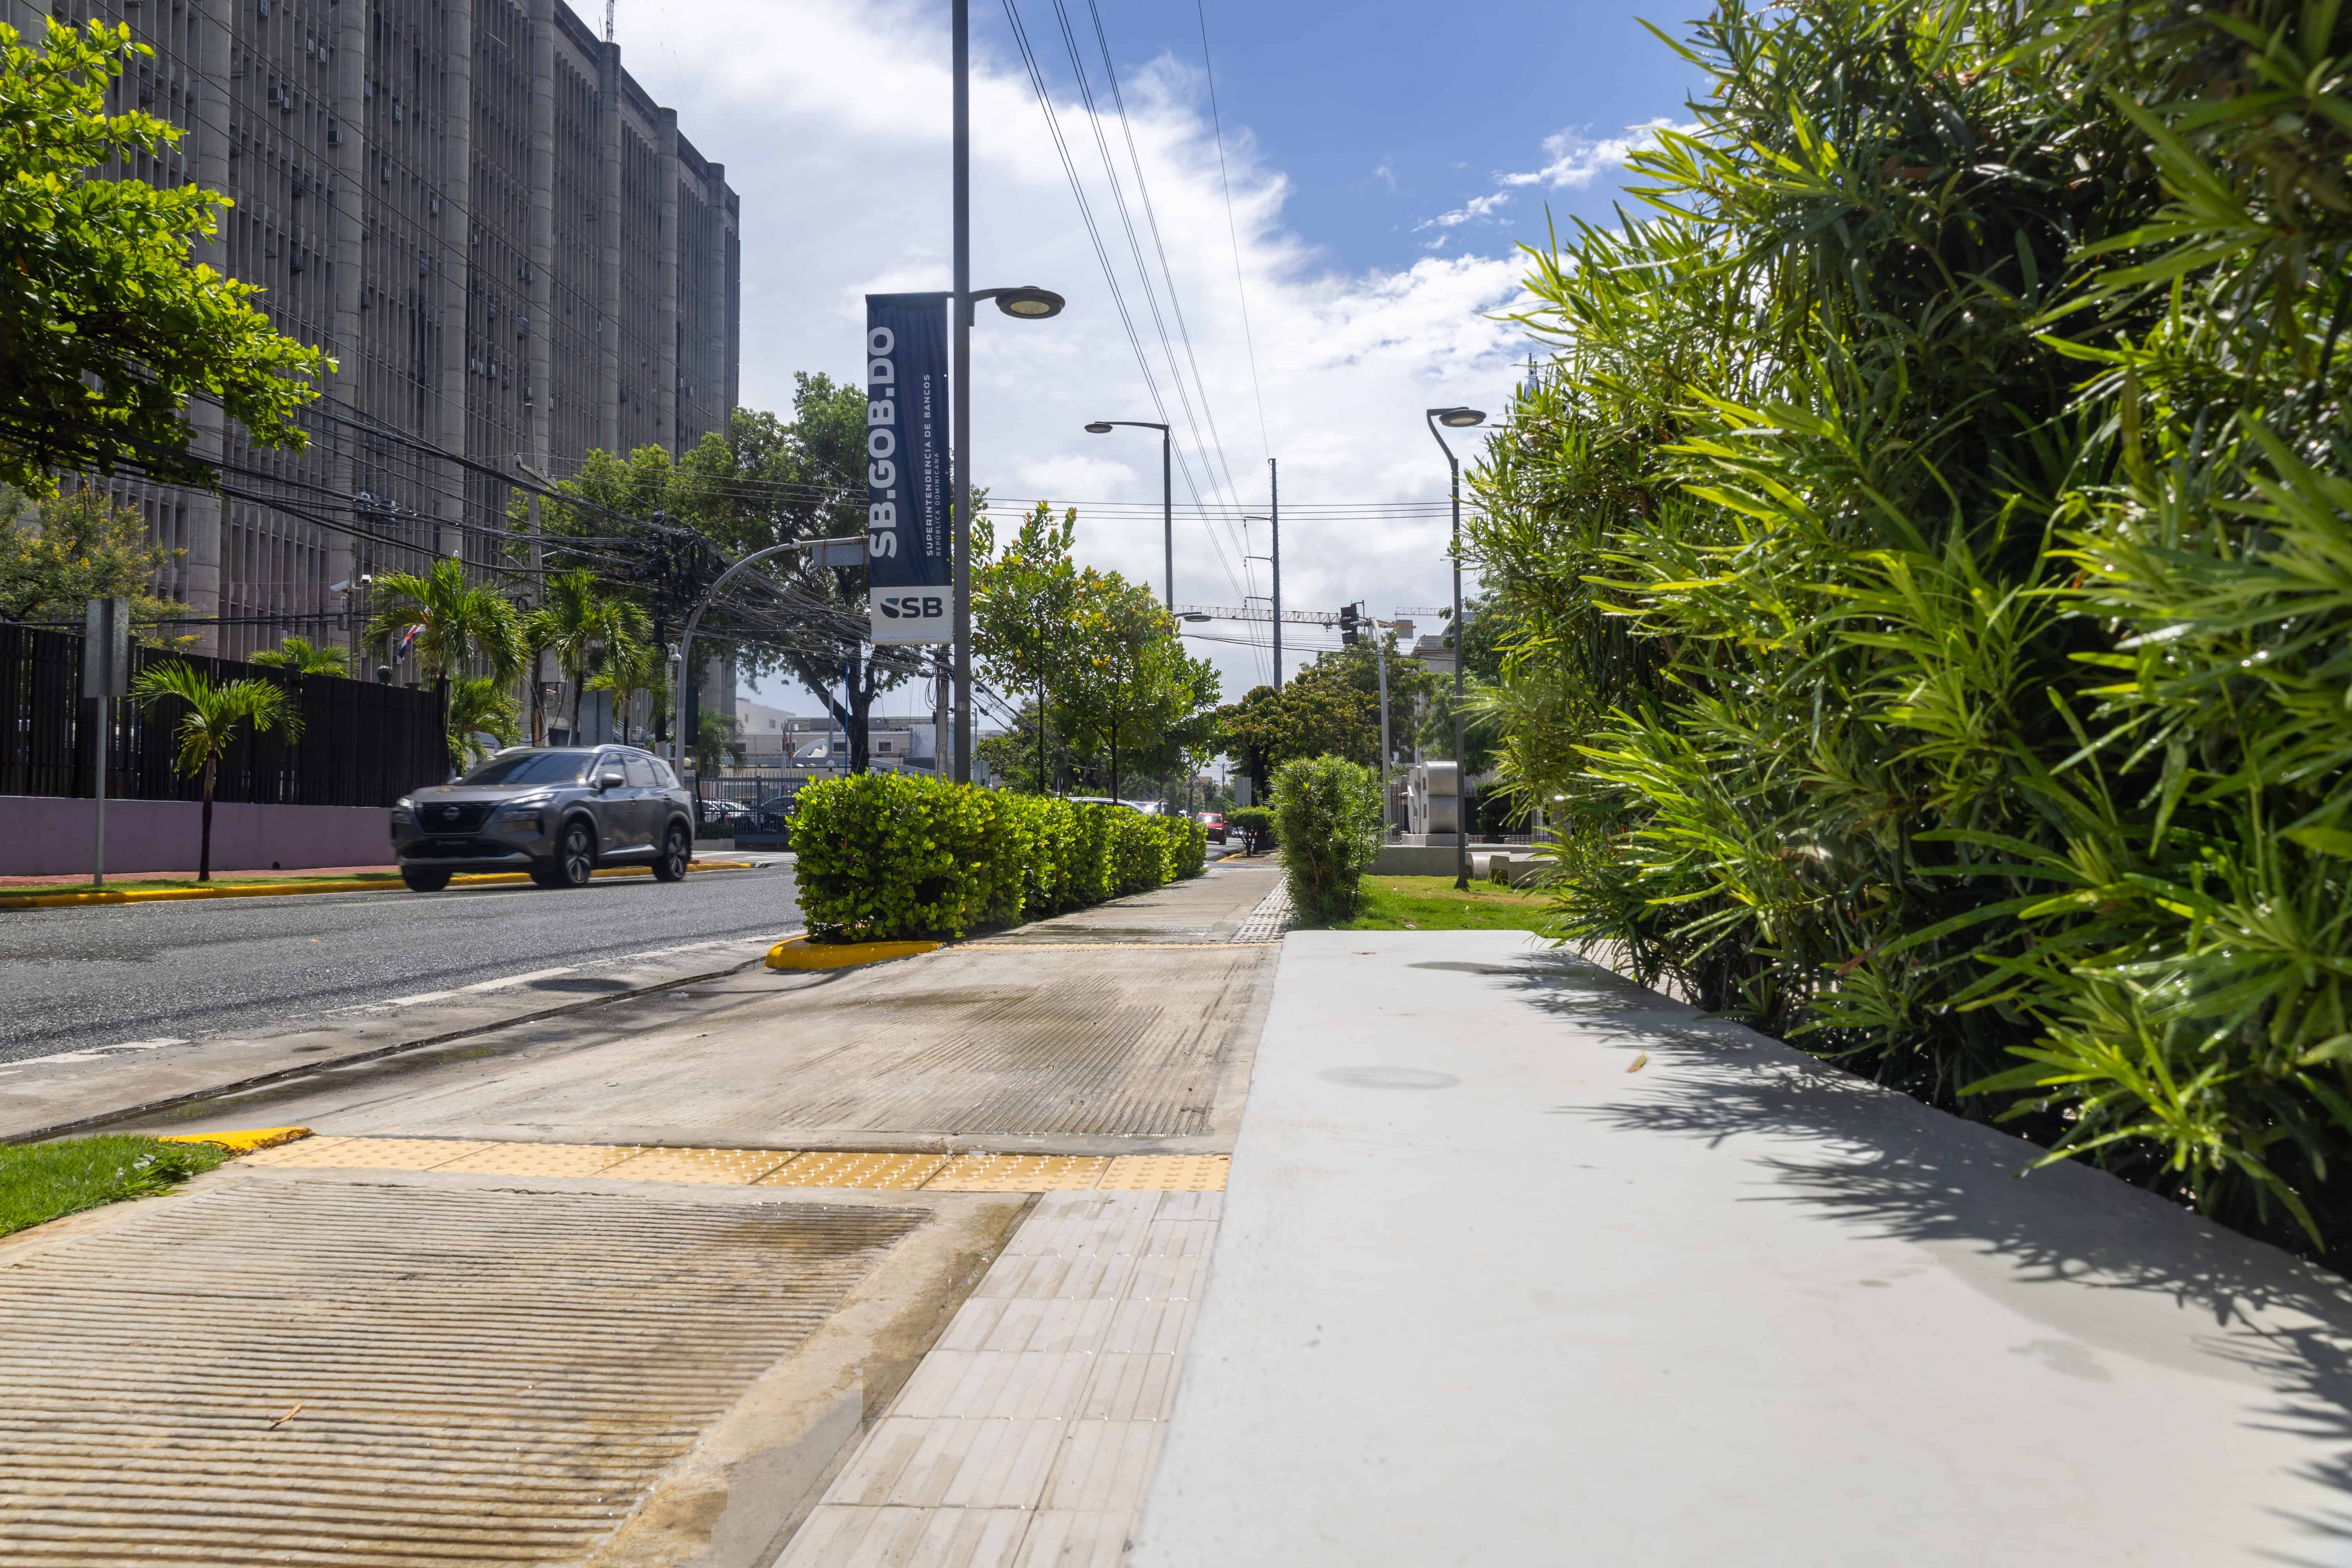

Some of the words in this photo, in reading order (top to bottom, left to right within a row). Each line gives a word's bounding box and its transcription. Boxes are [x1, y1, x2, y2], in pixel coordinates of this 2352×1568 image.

[867, 327, 897, 559] SB.GOB.DO
[924, 423, 931, 437] DE
[925, 441, 933, 556] SUPERINTENDENCIA
[902, 597, 943, 618] SB
